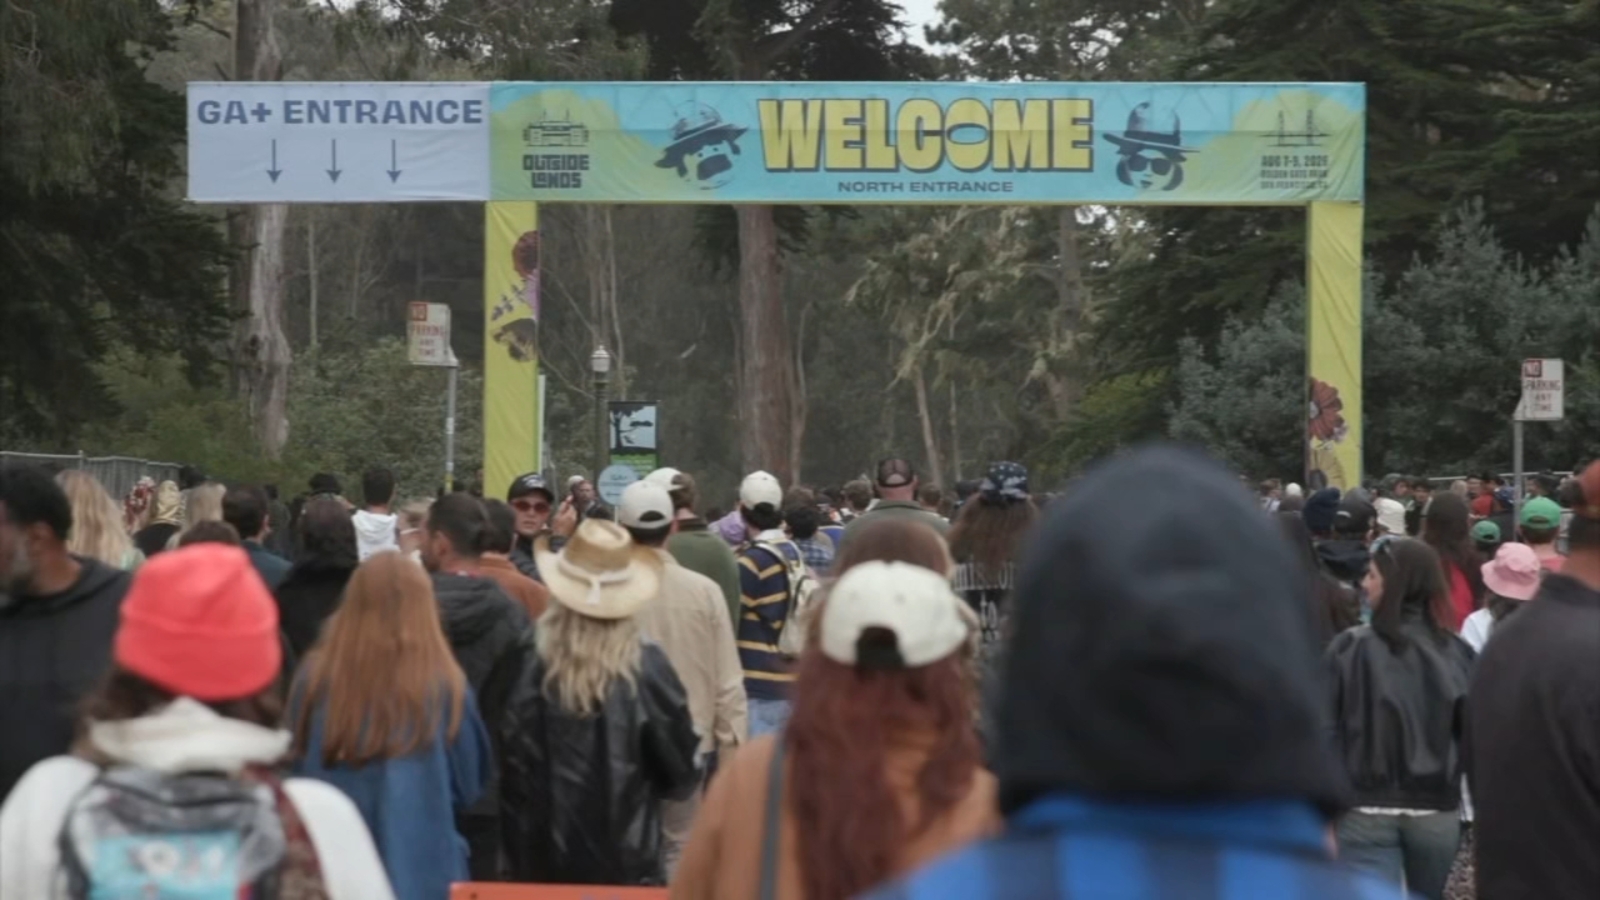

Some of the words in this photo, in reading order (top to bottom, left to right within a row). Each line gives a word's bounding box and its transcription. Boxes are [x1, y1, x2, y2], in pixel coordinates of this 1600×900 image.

[196, 99, 273, 125] GA+
[283, 99, 483, 125] ENTRANCE
[756, 97, 1095, 173] WELCOME
[523, 154, 590, 171] OUTSIDE
[1262, 155, 1281, 167] AUG
[838, 180, 902, 193] NORTH
[909, 180, 1014, 193] ENTRANCE
